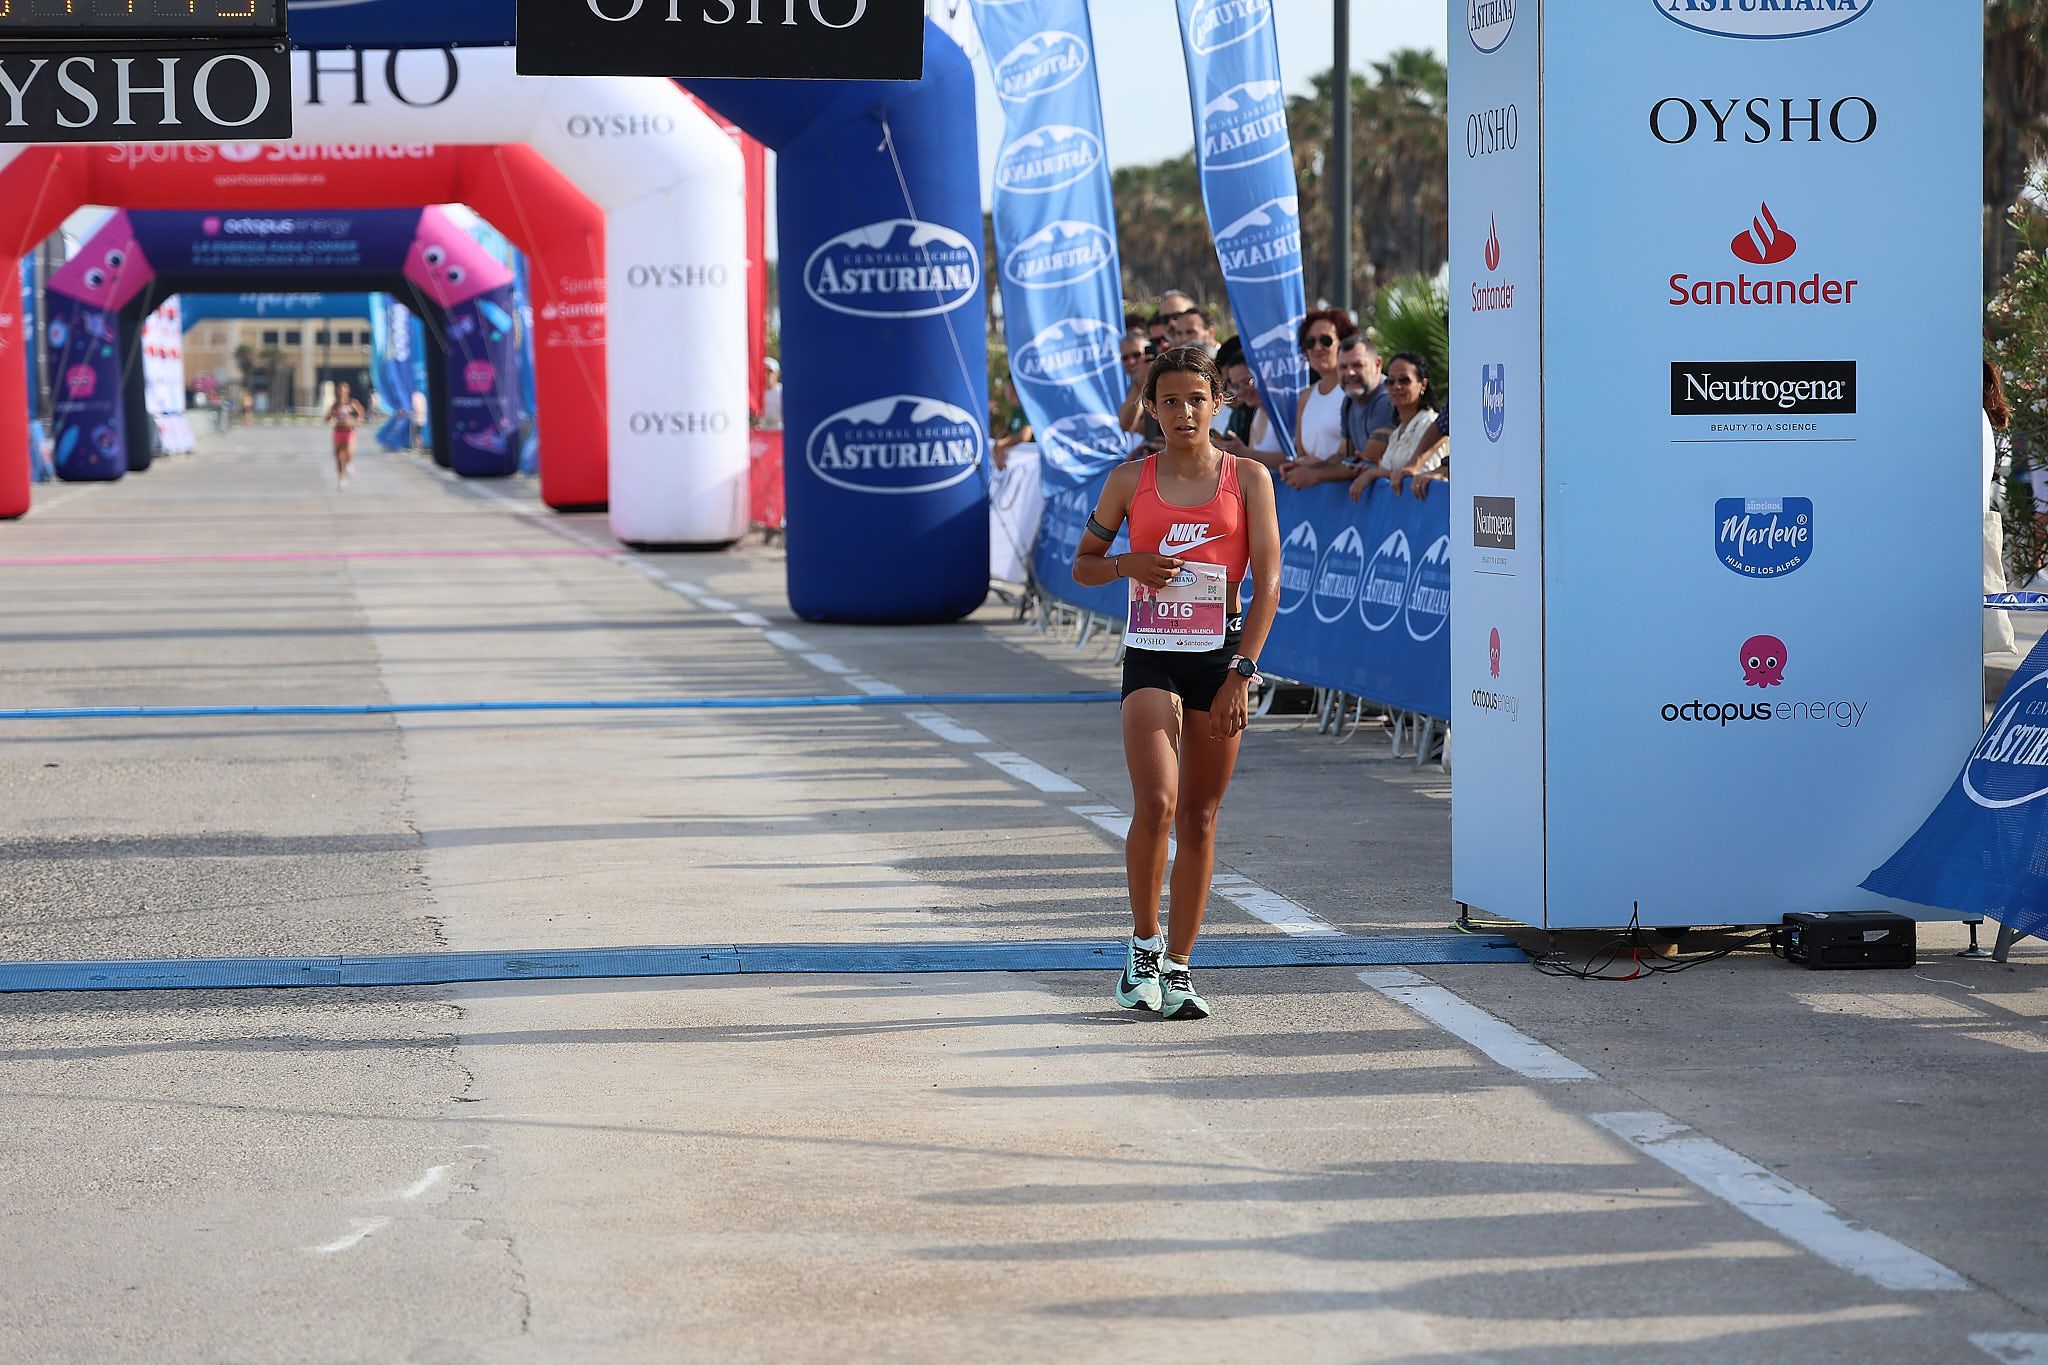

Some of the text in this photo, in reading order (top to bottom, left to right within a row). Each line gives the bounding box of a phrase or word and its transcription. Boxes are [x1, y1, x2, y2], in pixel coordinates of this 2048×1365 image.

[567, 113, 675, 138] OYSHO
[1467, 103, 1518, 159] OYSHO
[1649, 96, 1877, 144] OYSHO
[223, 216, 294, 236] octopus
[627, 263, 729, 289] OYSHO
[816, 256, 973, 295] ASTURIANA
[1669, 273, 1858, 305] Santander
[1471, 279, 1515, 312] Santander
[1683, 373, 1844, 408] Neutrogena
[629, 410, 730, 435] OYSHO
[1711, 424, 1748, 432] BEAUTY
[1776, 423, 1817, 431] SCIENCE
[818, 431, 976, 470] ASTURIANA
[1167, 524, 1210, 542] NIKE
[1475, 507, 1514, 543] Neutrogena
[1725, 555, 1801, 574] HIJA DE LOS ALPES
[1158, 603, 1193, 617] 016
[1135, 637, 1166, 646] OYSHO
[1472, 686, 1519, 723] octopus energy
[1661, 699, 1868, 728] octopus energy
